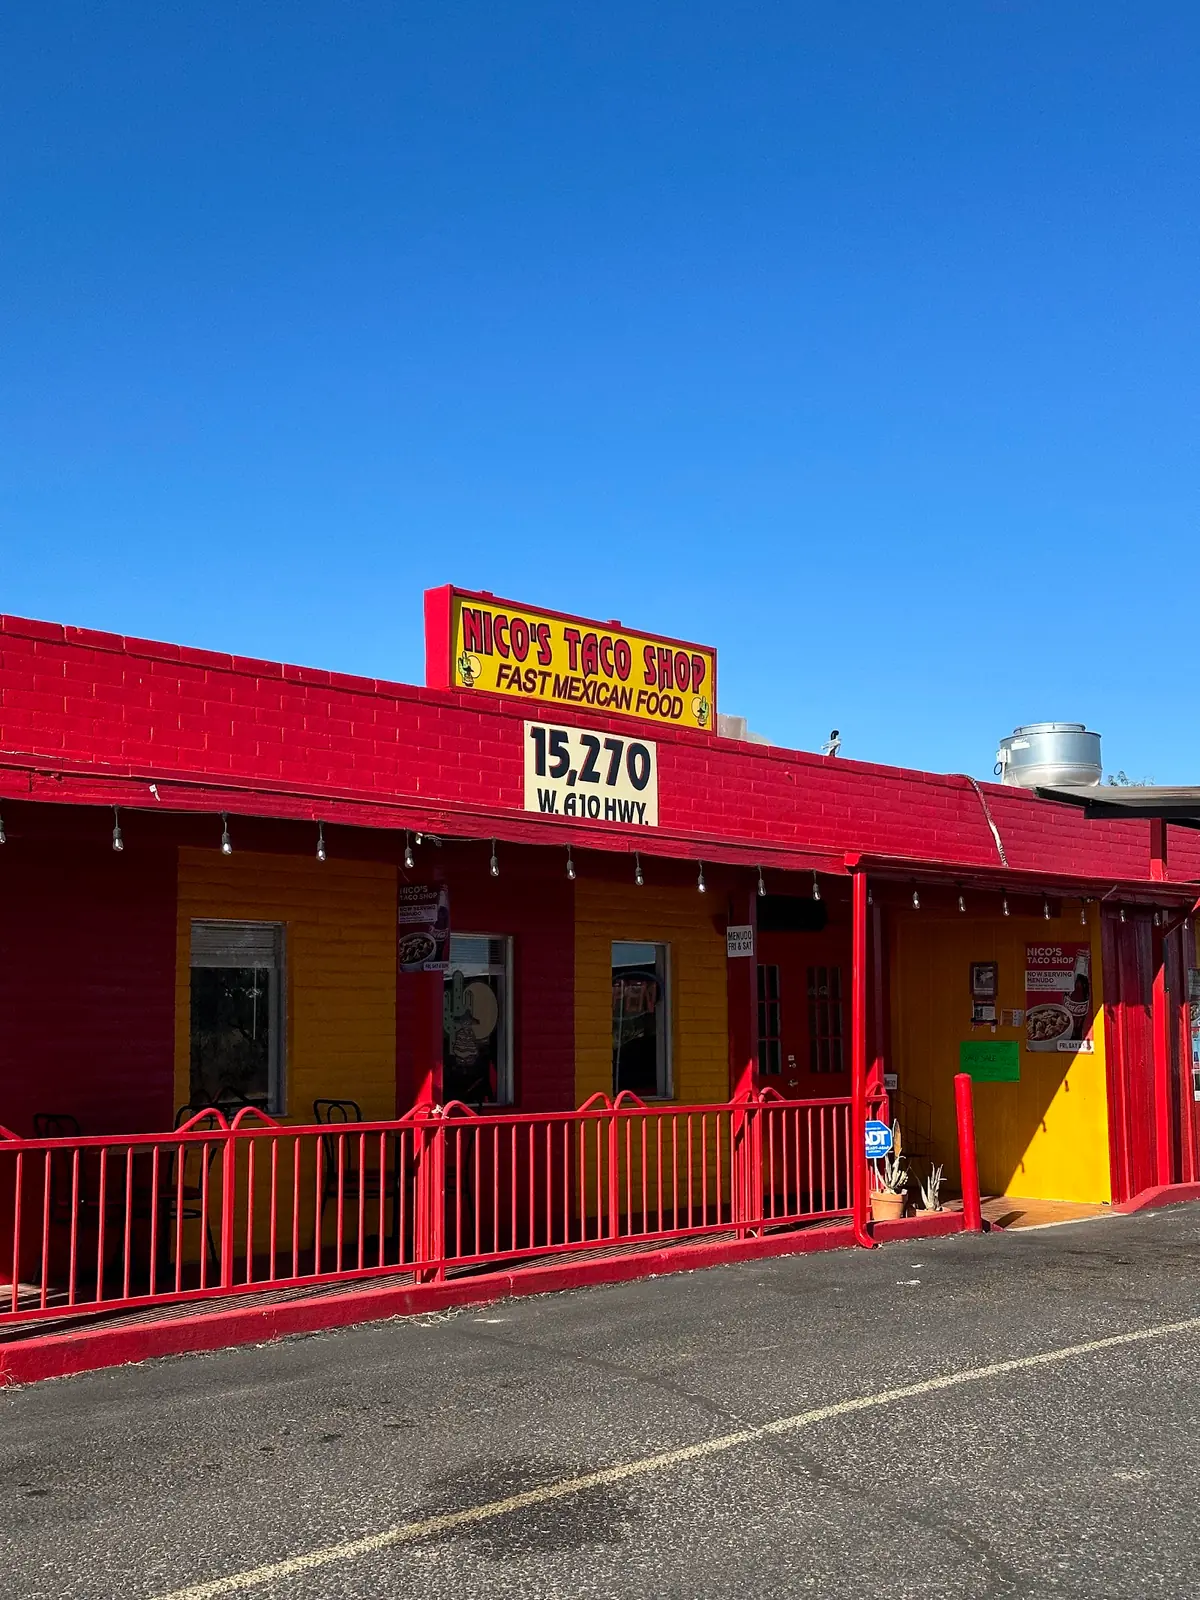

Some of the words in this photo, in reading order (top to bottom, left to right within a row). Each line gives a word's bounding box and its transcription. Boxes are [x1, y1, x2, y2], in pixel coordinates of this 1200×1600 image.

[462, 606, 552, 666] NICO'S
[564, 627, 632, 681] TACO
[643, 645, 706, 694] SHOP
[496, 663, 552, 696] FAST
[552, 673, 633, 711] MEXICAN
[635, 689, 684, 719] FOOD
[530, 726, 651, 791] 15,270
[537, 788, 559, 814] W.
[604, 797, 649, 825] HWY.
[728, 943, 737, 951] FRI
[738, 942, 742, 951] &
[742, 941, 752, 950] SAT
[1027, 947, 1063, 956] NICO'S
